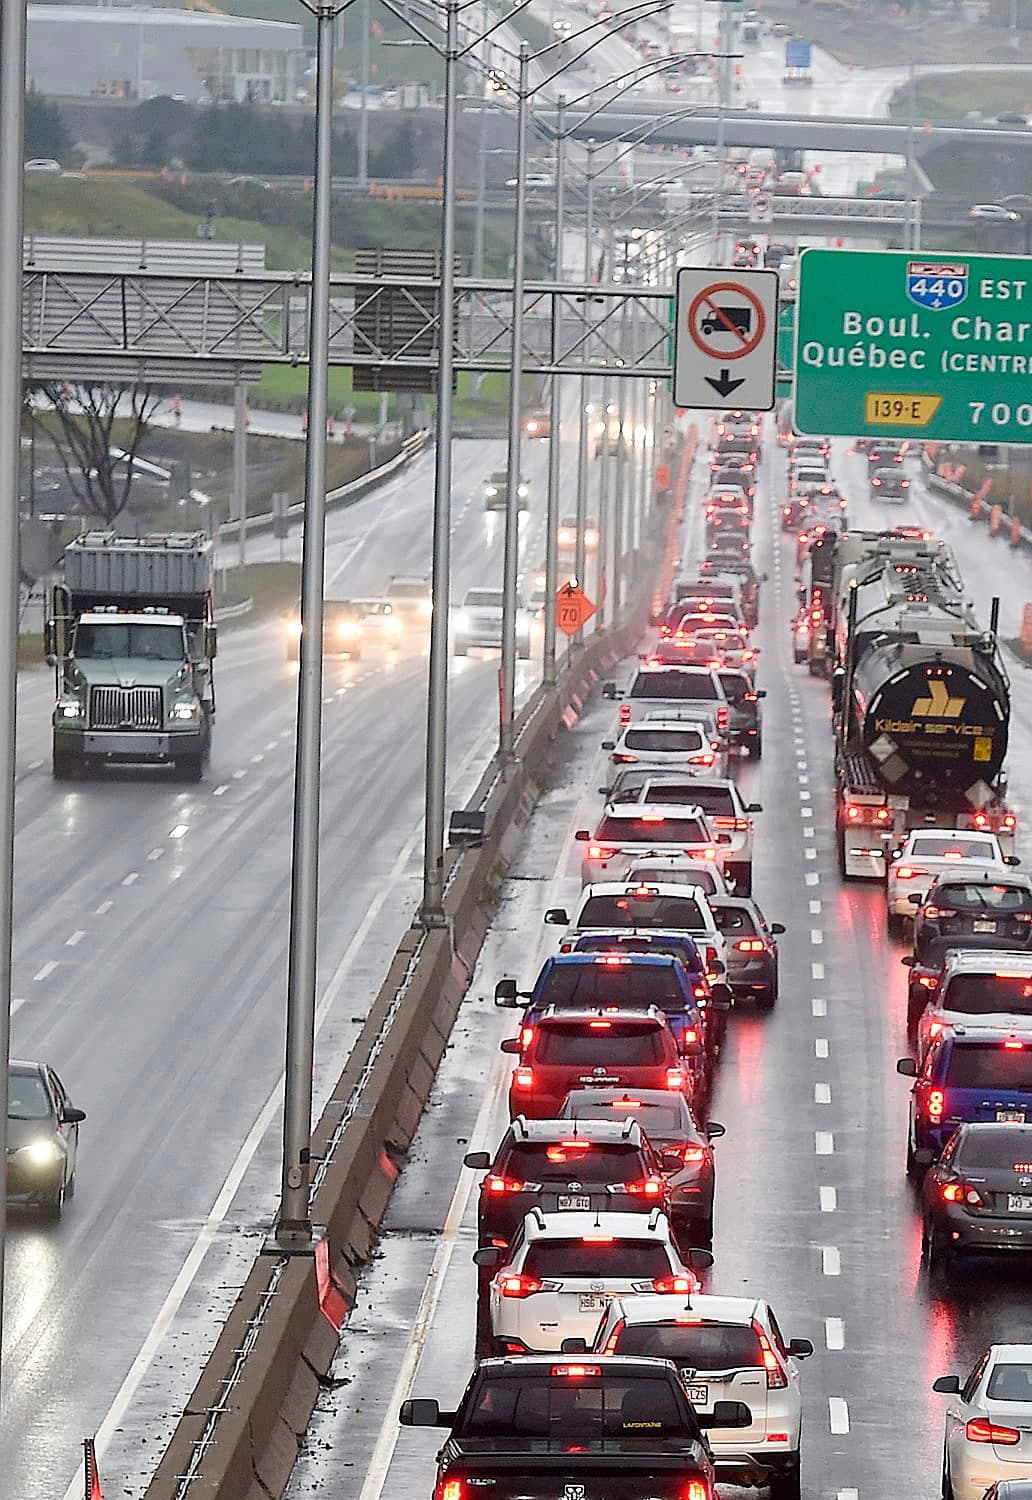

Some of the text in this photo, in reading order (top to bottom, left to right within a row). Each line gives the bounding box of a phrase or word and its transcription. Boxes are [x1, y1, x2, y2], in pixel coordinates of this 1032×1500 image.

[910, 277, 1027, 300] 440 EST
[843, 311, 931, 339] Boul.
[802, 341, 926, 370] Québec
[873, 399, 921, 419] 139-E
[562, 608, 577, 622] 70
[874, 719, 922, 733] Kildair
[924, 723, 983, 735] service
